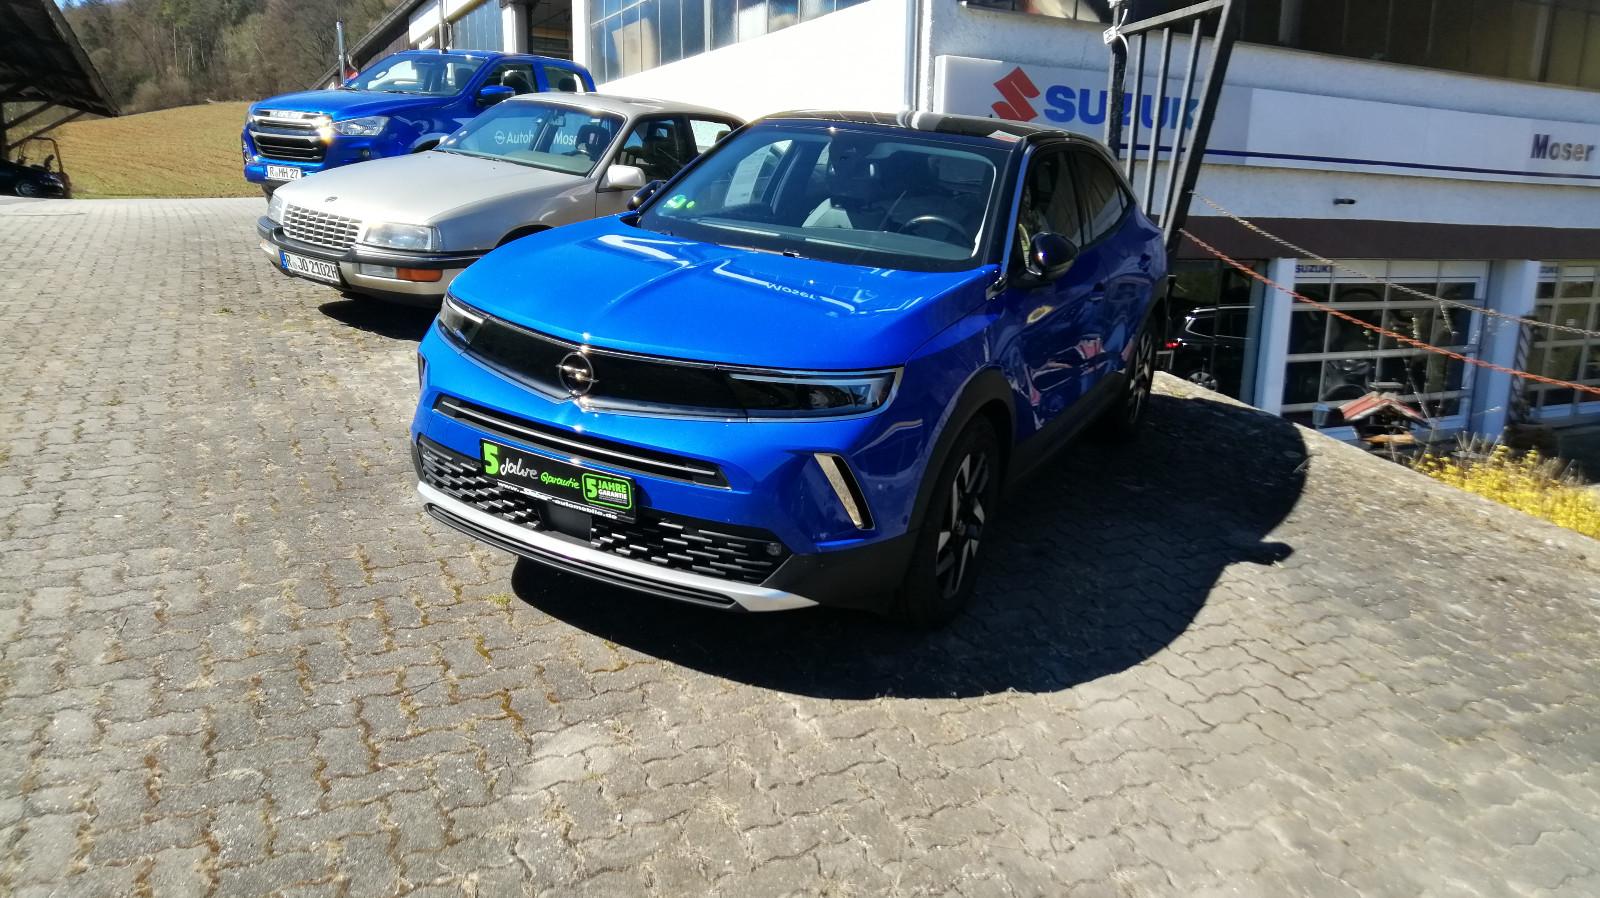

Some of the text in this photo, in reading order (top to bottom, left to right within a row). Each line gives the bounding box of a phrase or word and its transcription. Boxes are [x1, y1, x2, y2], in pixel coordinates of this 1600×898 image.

[1044, 85, 1200, 130] SUUK
[506, 129, 578, 145] Autoh Mos
[1530, 133, 1595, 161] Moser
[289, 168, 299, 179] 27
[285, 253, 293, 268] R
[483, 442, 499, 475] 5
[586, 477, 627, 498] 5 JAHRE
[598, 489, 628, 500] GARANTIE
